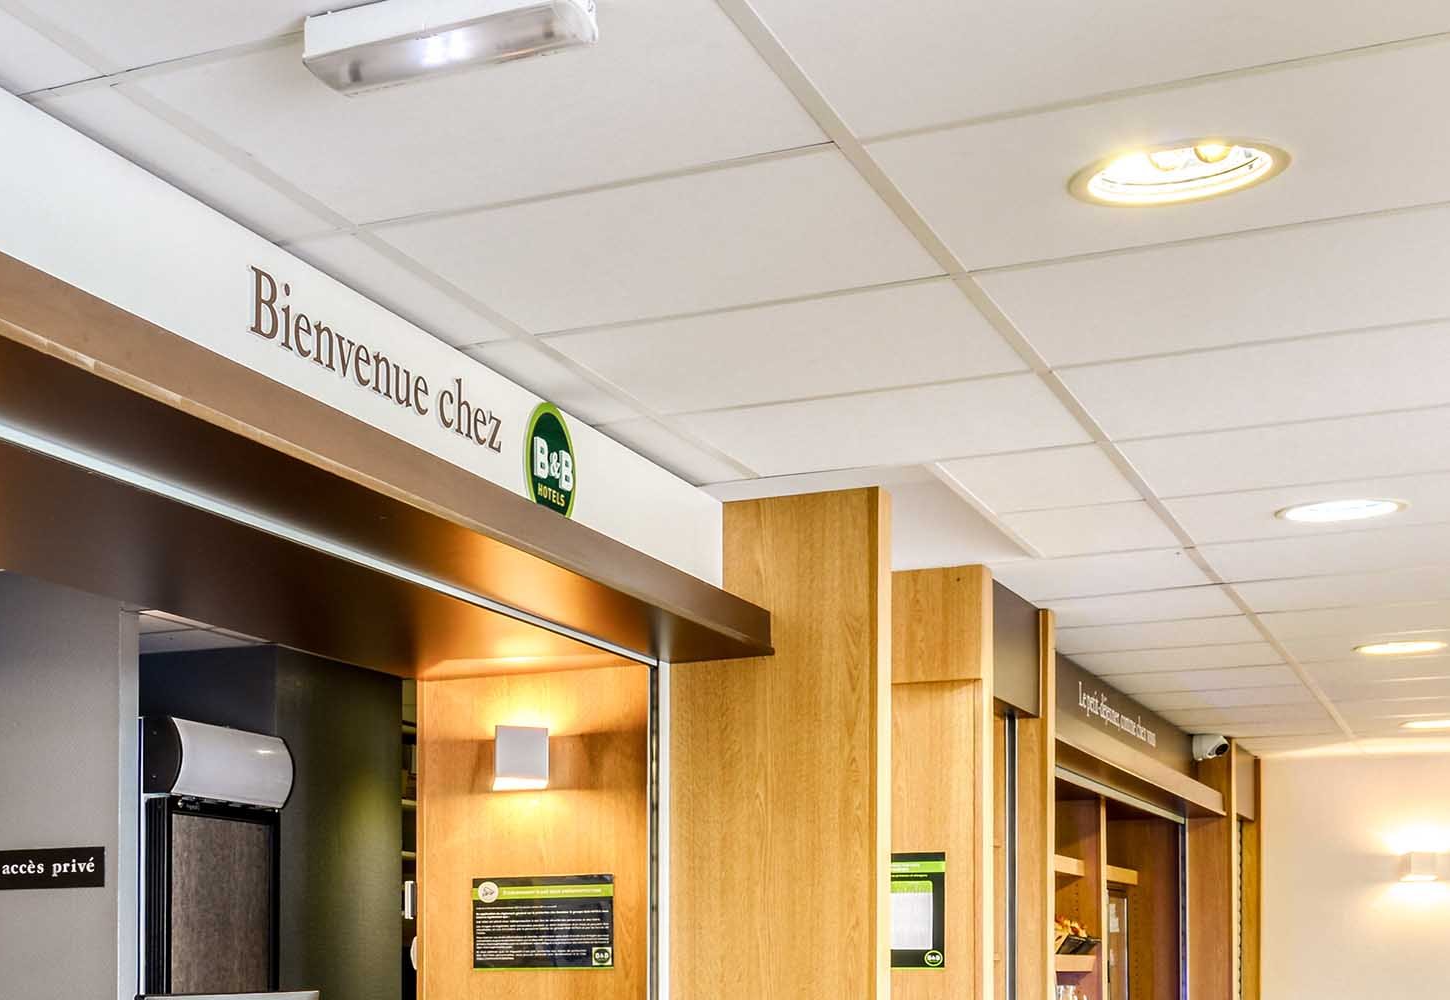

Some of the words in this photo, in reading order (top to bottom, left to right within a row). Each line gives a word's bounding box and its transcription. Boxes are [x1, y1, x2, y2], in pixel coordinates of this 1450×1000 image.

[249, 264, 430, 417] Bienvenue
[438, 378, 503, 454] chez
[533, 436, 575, 492] B&B
[537, 482, 566, 508] HOTELS
[1, 859, 45, 876] accès
[51, 856, 96, 878] privé
